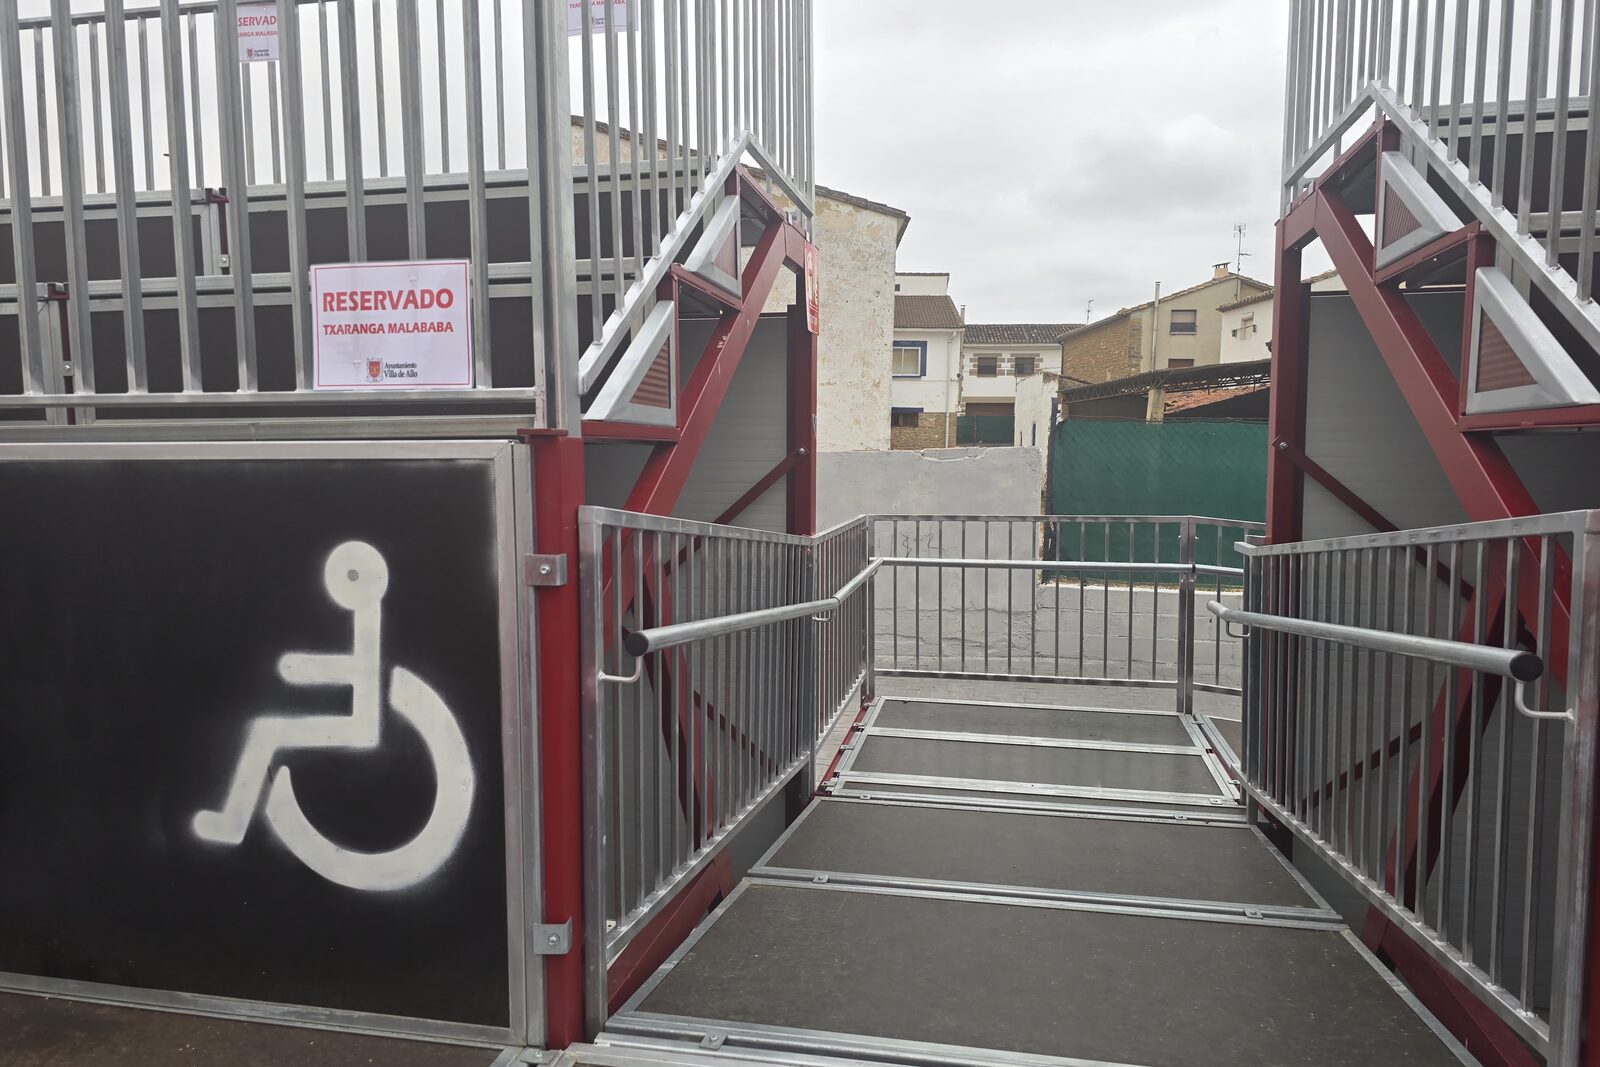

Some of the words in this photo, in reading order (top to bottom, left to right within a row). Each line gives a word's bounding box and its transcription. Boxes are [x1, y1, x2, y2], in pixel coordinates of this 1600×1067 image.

[238, 15, 277, 27] SERVAD
[323, 288, 454, 312] RESERVADO
[323, 323, 386, 335] TXARANGA
[388, 321, 454, 333] MALABABA
[398, 370, 405, 378] de
